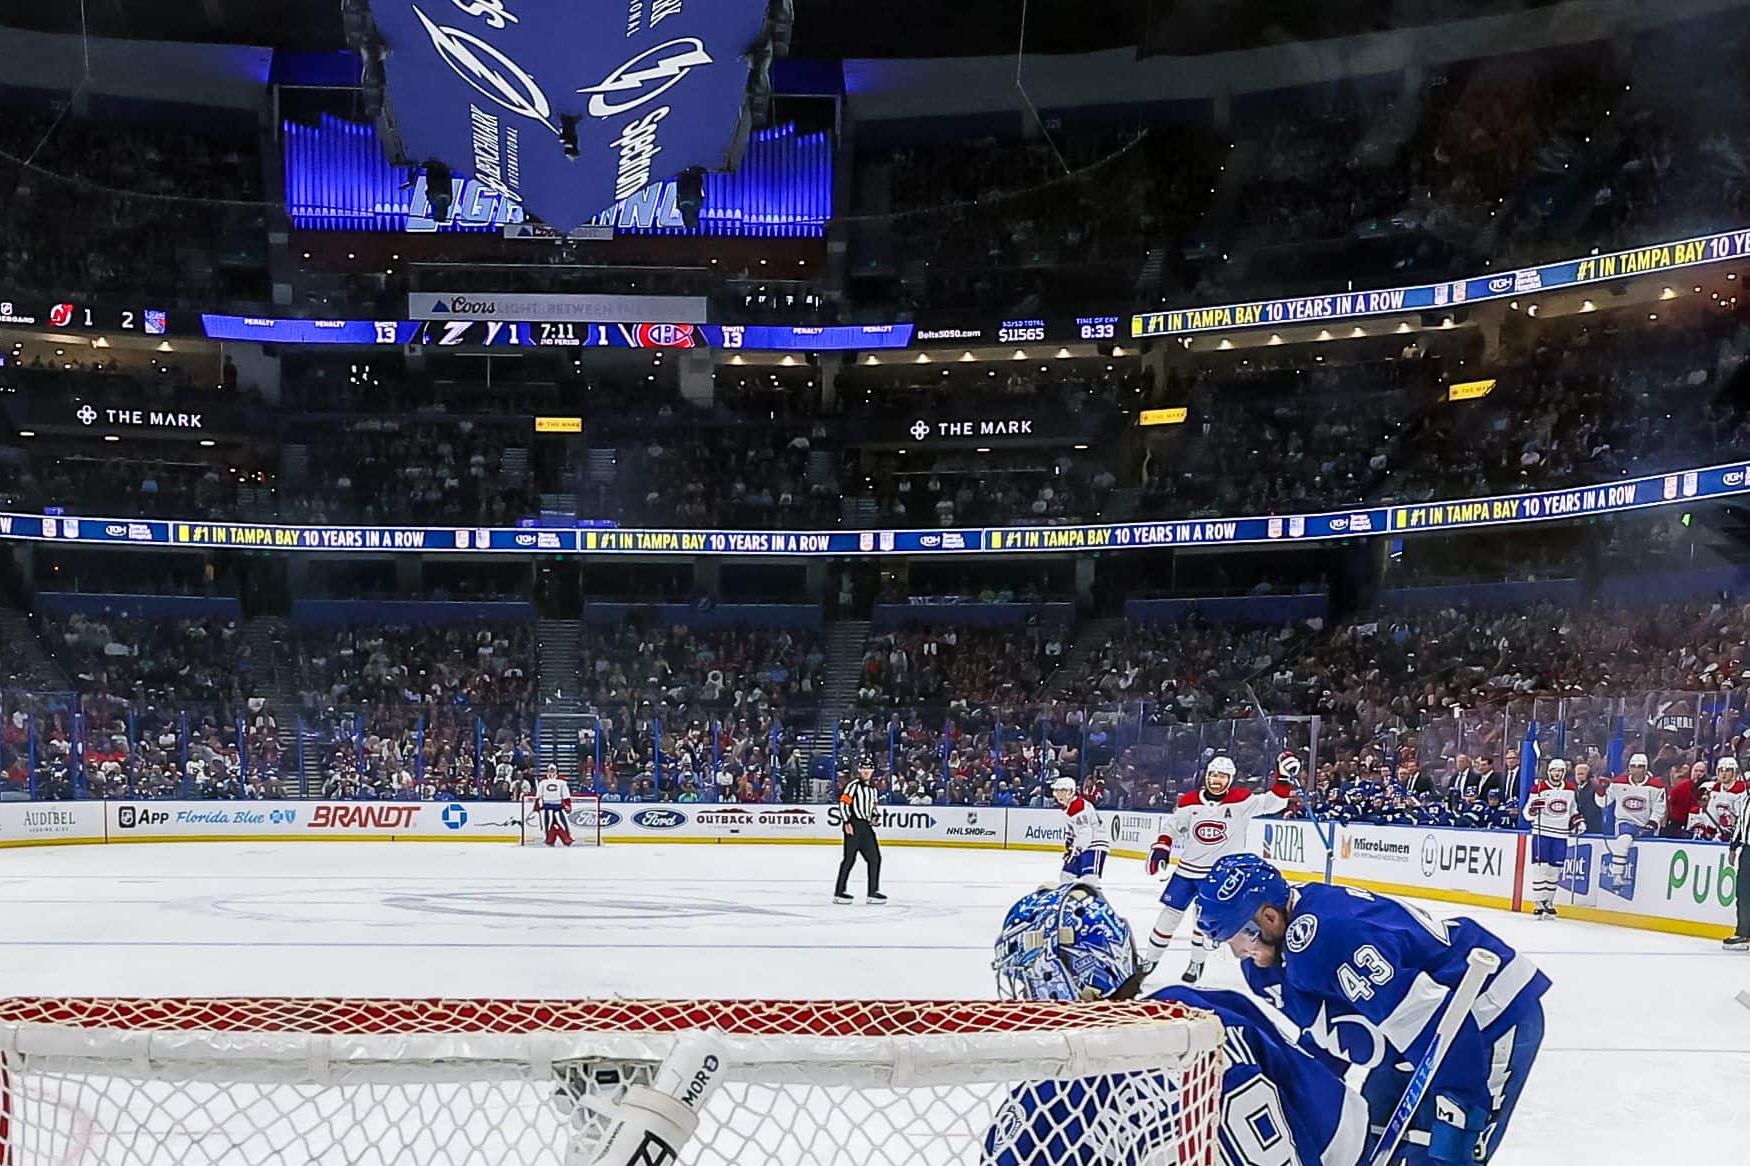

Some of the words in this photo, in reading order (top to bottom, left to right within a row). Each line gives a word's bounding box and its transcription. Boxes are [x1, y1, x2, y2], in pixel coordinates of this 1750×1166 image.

[611, 106, 670, 201] Spectrum
[1577, 260, 1595, 281] #1
[1599, 258, 1615, 277] IN
[1620, 246, 1669, 274] TAMPA
[1674, 240, 1706, 264] BAY
[1710, 236, 1729, 257] 10
[450, 296, 496, 314] Coors
[1148, 315, 1164, 332] #1
[1168, 314, 1182, 331] IN
[1186, 310, 1232, 329] TAMPA
[1235, 305, 1261, 325] BAY
[1265, 303, 1283, 321] 10
[1287, 299, 1331, 319] YEARS
[1336, 297, 1351, 314] IN
[1355, 296, 1366, 313] A
[1369, 291, 1404, 311] ROW
[84, 309, 92, 326] 1
[122, 312, 133, 329] 2
[244, 319, 274, 327] PENALTY
[375, 327, 396, 343] 13
[509, 324, 519, 344] 1
[540, 324, 573, 338] 7:11
[598, 325, 608, 345] 1
[723, 332, 743, 348] 13
[999, 327, 1045, 342] $11565
[1081, 325, 1114, 339] 8:33
[106, 410, 143, 424] THE
[150, 412, 202, 429] MARK
[938, 422, 973, 435] THE
[981, 420, 1032, 434] MARK
[1410, 508, 1426, 525] #1
[1429, 507, 1442, 524] IN
[1447, 504, 1490, 523] TAMPA
[1493, 500, 1519, 518] BAY
[1523, 499, 1540, 516] 10
[1543, 495, 1580, 514] YEARS
[1583, 492, 1595, 510] IN
[1597, 490, 1606, 508] A
[1608, 484, 1637, 505] ROW
[24, 811, 76, 826] AUDIBEL
[176, 810, 230, 823] Florida
[232, 810, 265, 823] Blue
[307, 806, 421, 828] BRANDT
[641, 812, 680, 828] Ford
[696, 815, 753, 824] OUTBACK
[758, 815, 816, 825] OUTBACK
[1224, 808, 1232, 818] A
[1025, 825, 1068, 841] AdventH
[1273, 824, 1305, 863] RIPA
[1354, 838, 1410, 855] MicroLumen
[1440, 845, 1503, 876] UPEXI
[1220, 867, 1246, 896] TGH
[1666, 849, 1736, 907] Pub
[1336, 944, 1394, 1003] 43
